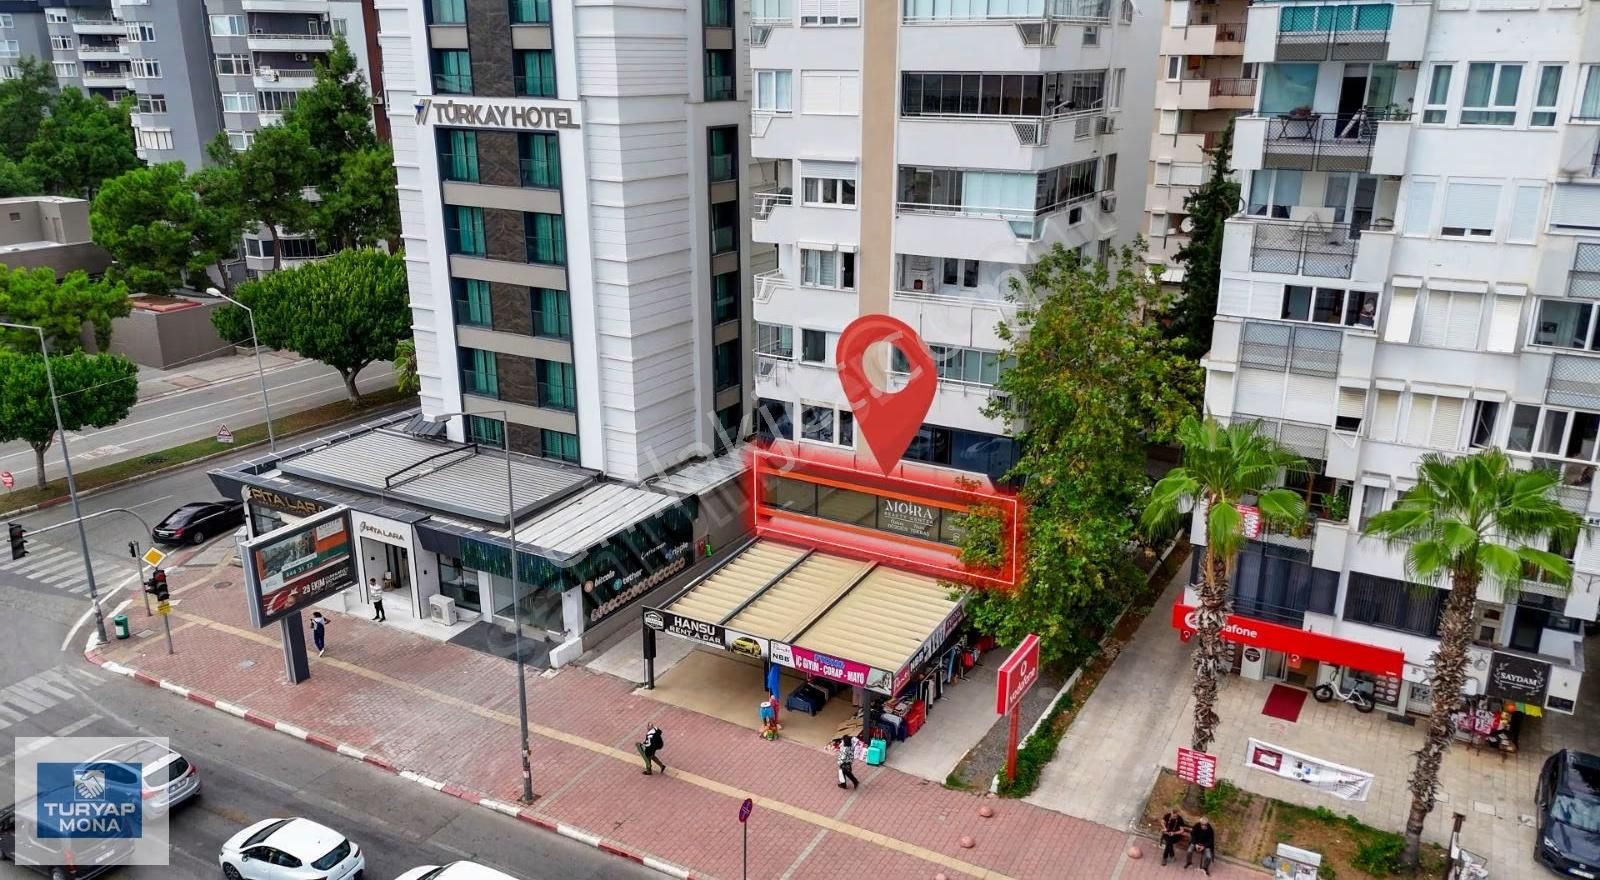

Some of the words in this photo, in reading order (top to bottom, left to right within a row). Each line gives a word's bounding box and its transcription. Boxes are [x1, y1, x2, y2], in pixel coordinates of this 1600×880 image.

[511, 106, 580, 129] HOTEL
[383, 530, 405, 541] LARA
[669, 625, 693, 637] RENT
[702, 634, 721, 644] CAR
[674, 616, 716, 636] HANSU
[1222, 623, 1258, 638] afone
[772, 653, 790, 663] NBB
[823, 665, 844, 679] ÇORAP
[847, 670, 865, 685] MAYO
[1500, 672, 1538, 686] SAYDAM
